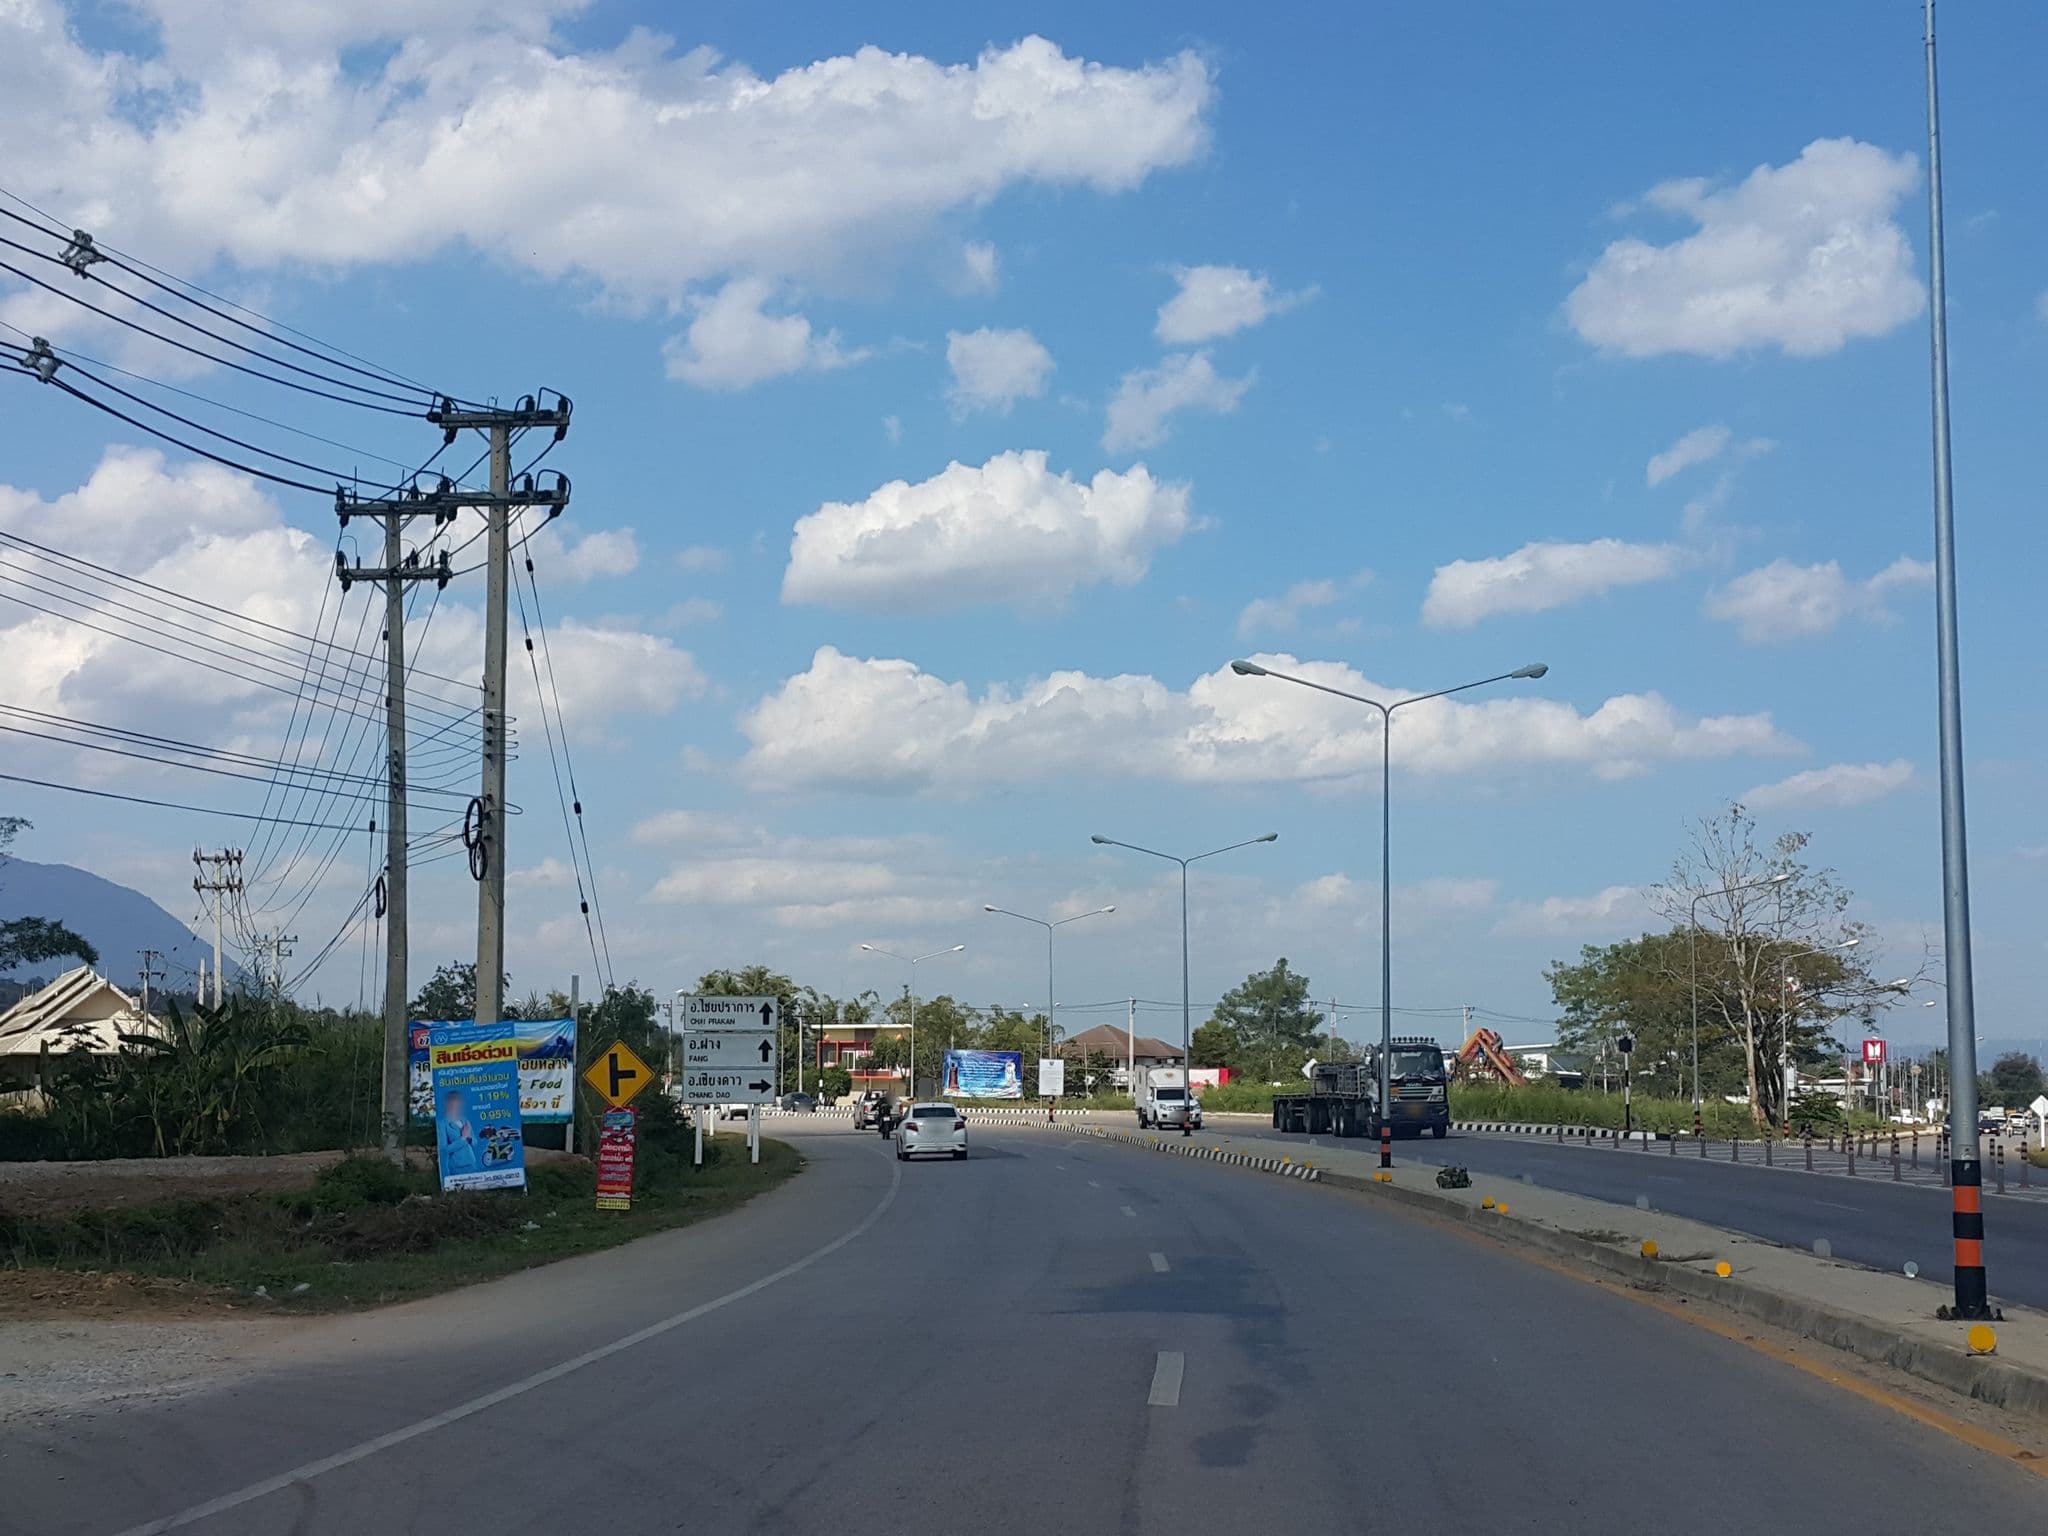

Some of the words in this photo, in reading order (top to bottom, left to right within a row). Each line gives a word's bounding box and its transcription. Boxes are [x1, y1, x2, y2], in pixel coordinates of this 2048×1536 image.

[690, 998, 755, 1013] อ.ไชยปราการ
[689, 1038, 721, 1050] อ.ฝาง
[436, 1044, 513, 1065] สินเชื่อด่วน
[530, 1078, 564, 1090] Food
[688, 1072, 742, 1087] อ.เชียงดาว
[688, 1091, 714, 1099] CHIANG
